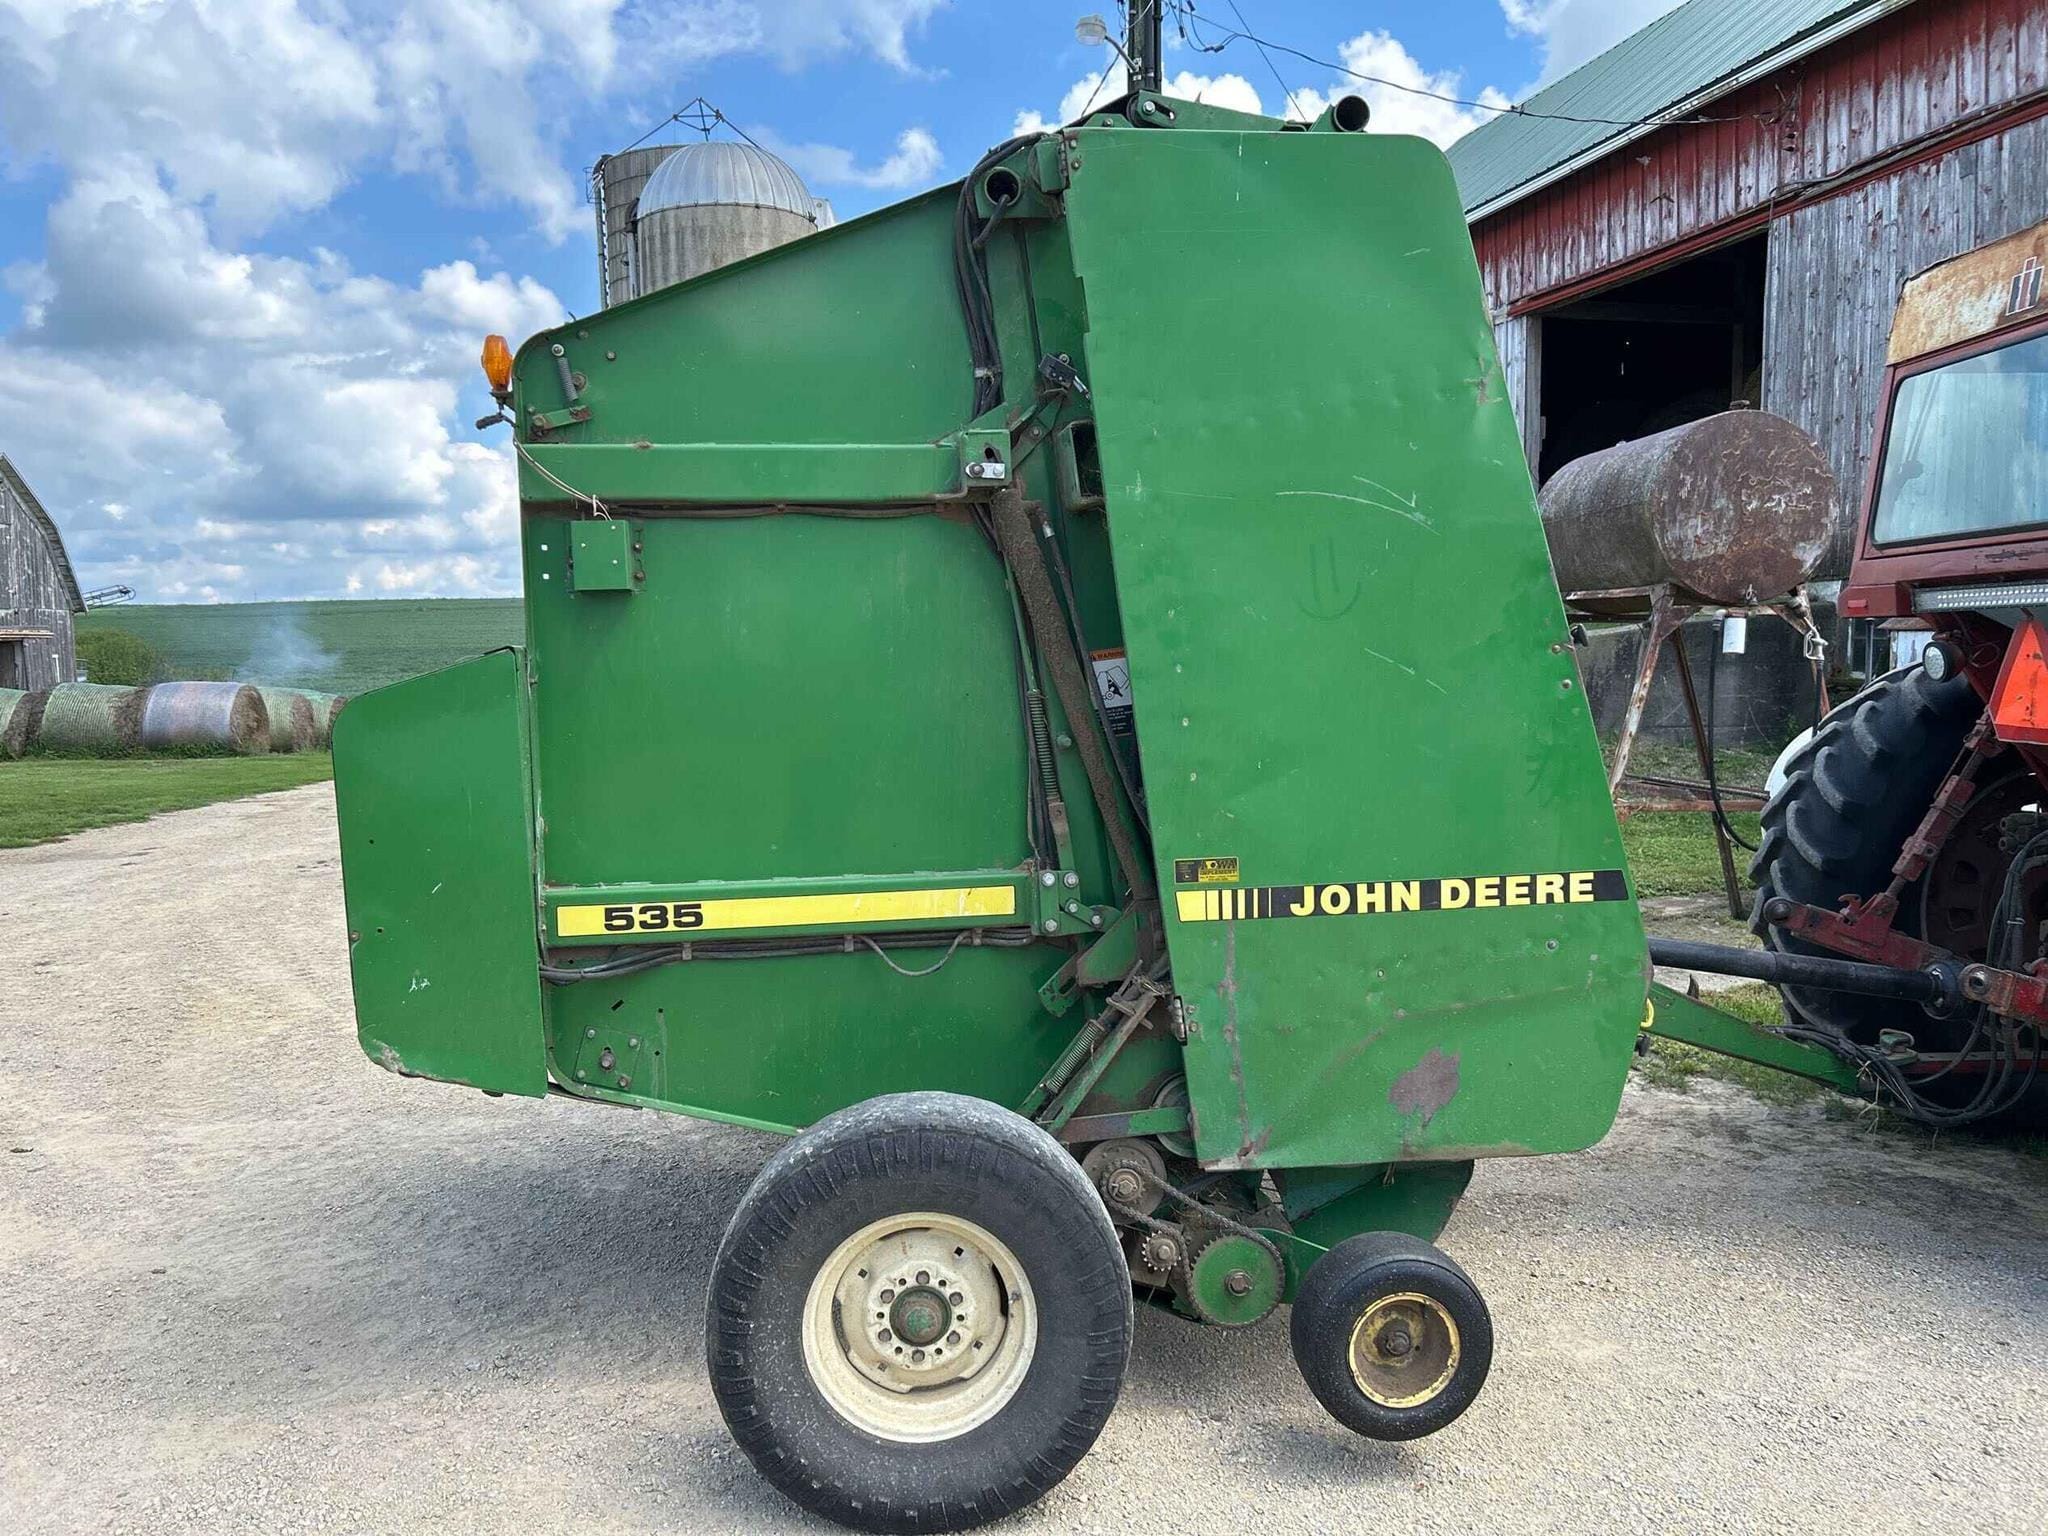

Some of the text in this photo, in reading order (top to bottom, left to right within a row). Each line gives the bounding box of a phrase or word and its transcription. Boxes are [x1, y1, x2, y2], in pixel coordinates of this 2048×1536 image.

[1290, 871, 1595, 917] JOHN DEERE
[604, 903, 704, 931] 535
